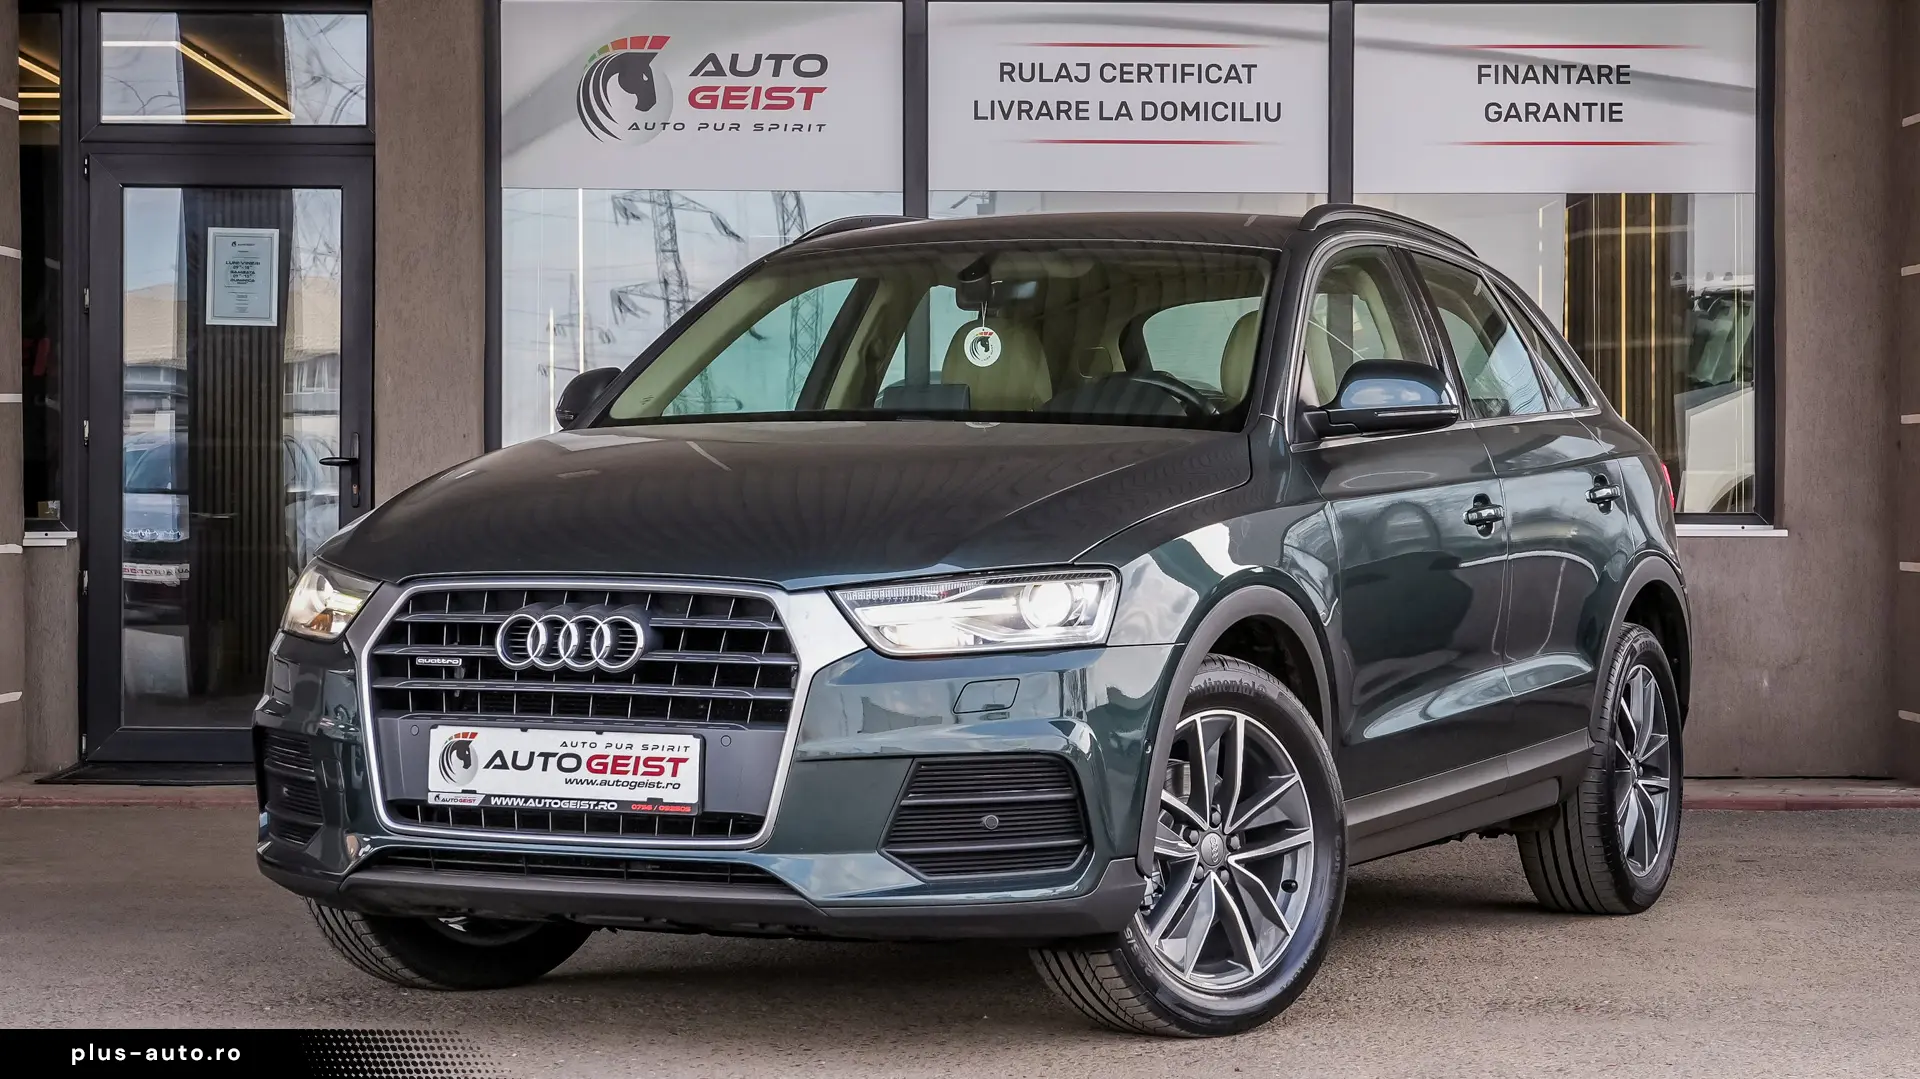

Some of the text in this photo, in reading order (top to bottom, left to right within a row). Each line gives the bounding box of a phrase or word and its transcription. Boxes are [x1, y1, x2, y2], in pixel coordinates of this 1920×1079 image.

[688, 52, 829, 78] AUTO
[999, 62, 1258, 84] RULAJ CERTIFICAT
[1477, 63, 1632, 85] FINANTARE
[687, 85, 828, 111] GEIST
[973, 99, 1282, 123] LIVRARE LA DOMICILIU
[1484, 102, 1624, 123] GARANTIE
[627, 121, 827, 133] AUTO PUR SPIRIT
[1188, 677, 1256, 698] ontinental
[559, 740, 691, 753] AUTO PUR SPIRIT
[482, 749, 689, 778] AUTOGEIST
[564, 778, 681, 791] www.autogeist.ro
[490, 796, 619, 811] WWW.AUTOGEIST.RO
